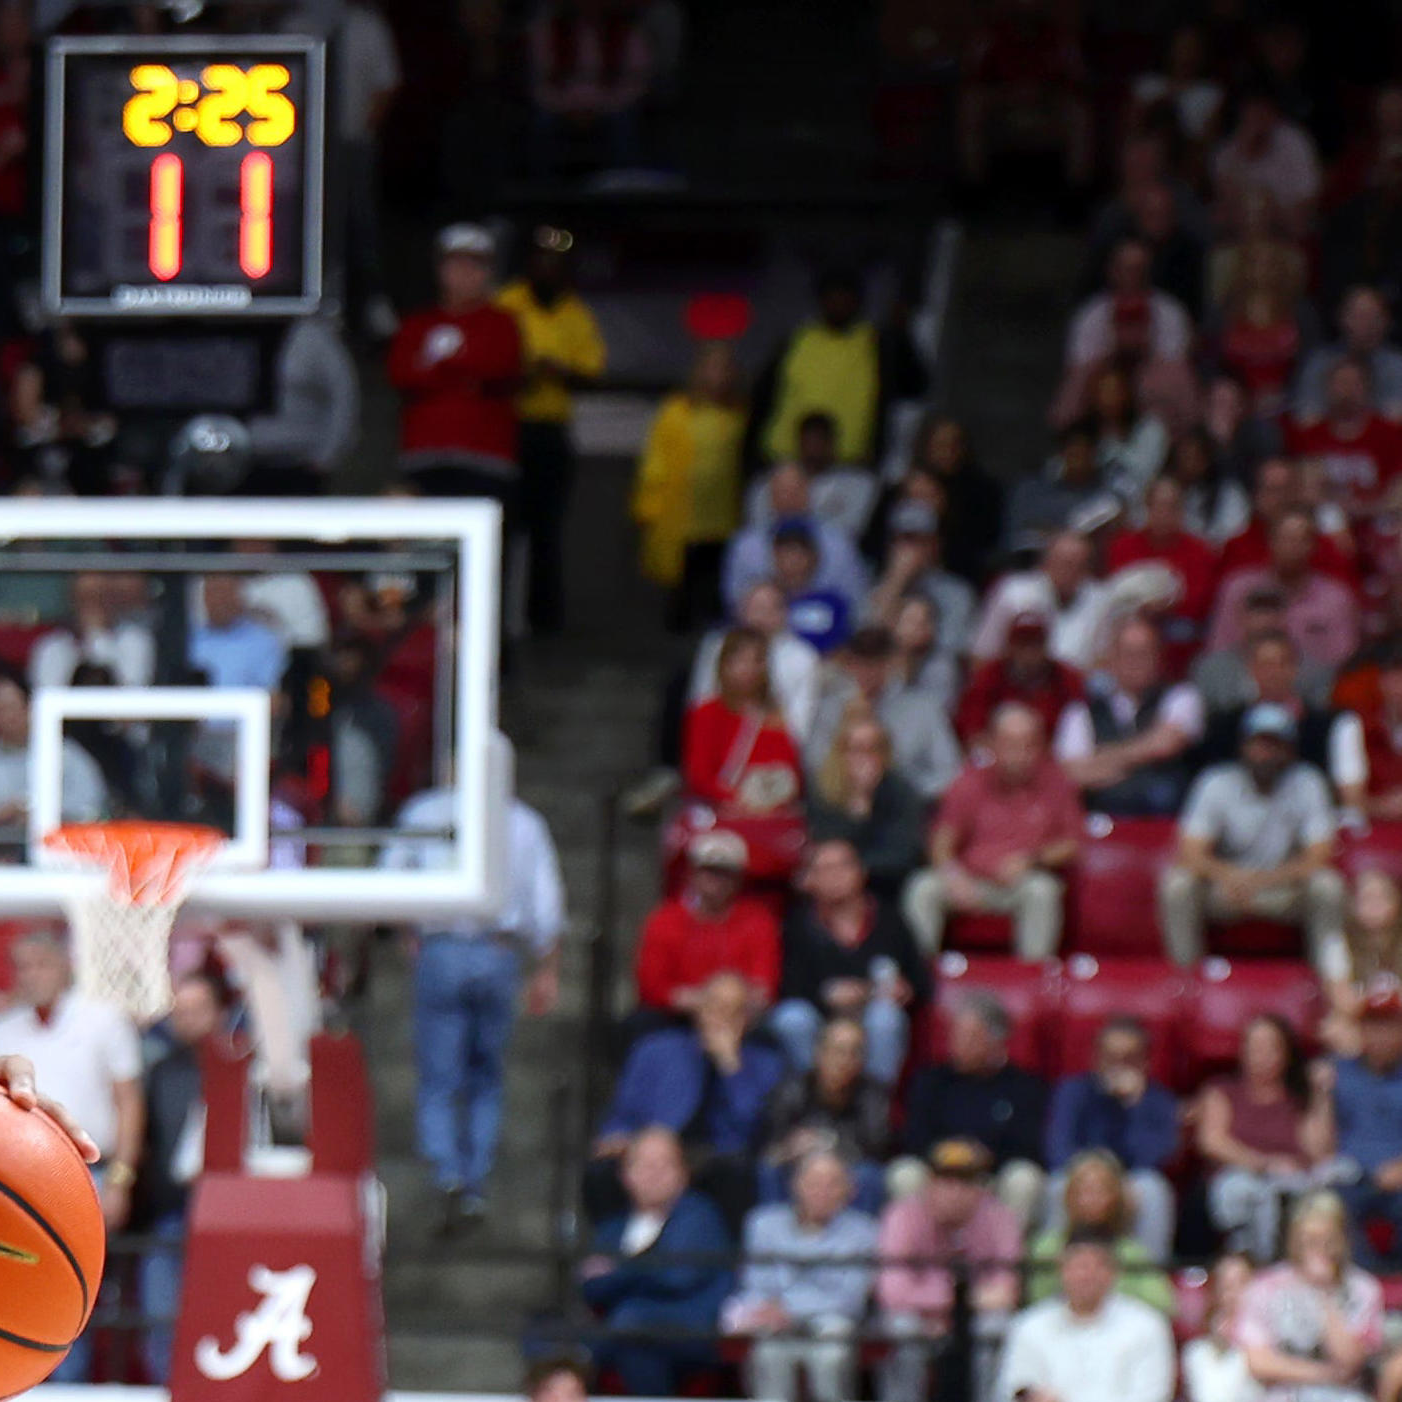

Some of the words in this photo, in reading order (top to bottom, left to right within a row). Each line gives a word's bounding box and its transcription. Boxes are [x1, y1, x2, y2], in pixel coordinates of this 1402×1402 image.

[123, 64, 295, 147] 2:25
[149, 152, 273, 281] 11
[196, 1263, 318, 1381] A
